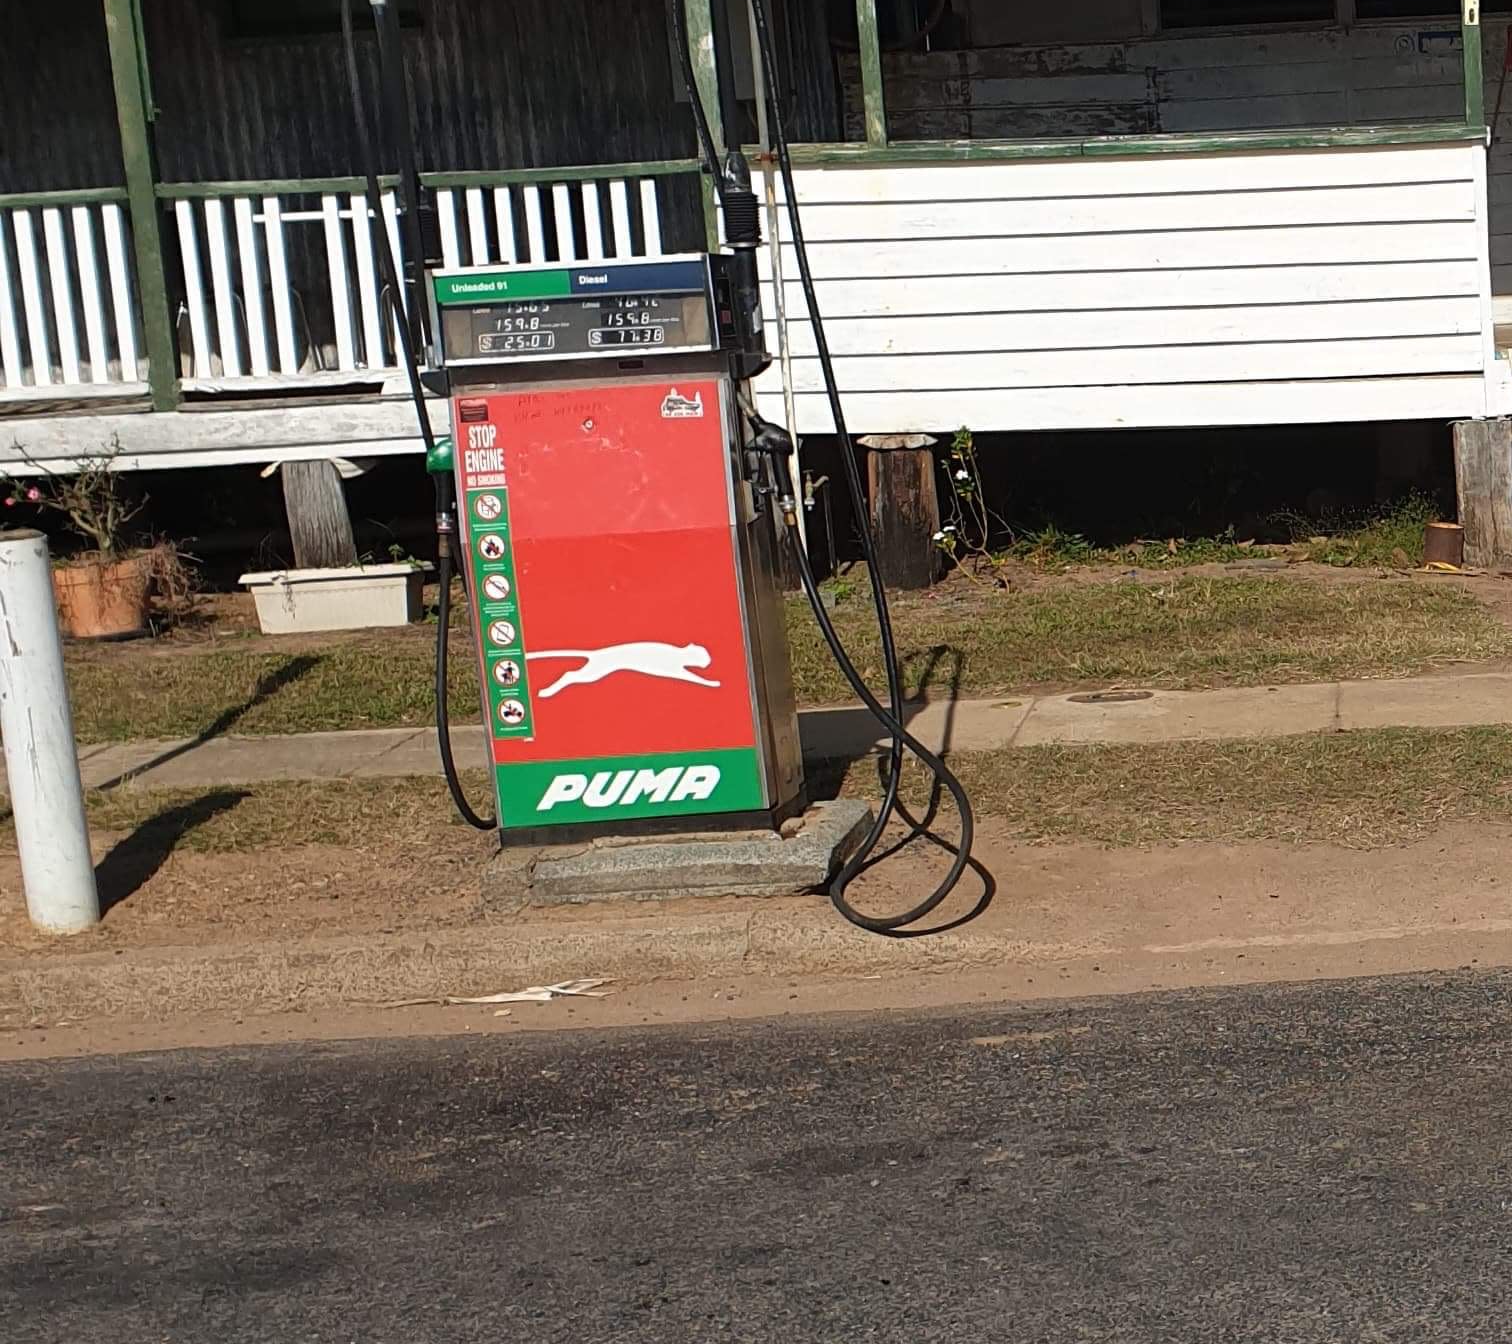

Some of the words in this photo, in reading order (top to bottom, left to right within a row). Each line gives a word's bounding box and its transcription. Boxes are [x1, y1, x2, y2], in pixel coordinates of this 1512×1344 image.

[451, 281, 495, 293] Unleaded
[496, 280, 508, 290] 91
[579, 273, 608, 285] Diesel
[468, 424, 497, 448] STOP
[464, 448, 505, 473] ENGINE
[535, 764, 721, 812] PUMA
